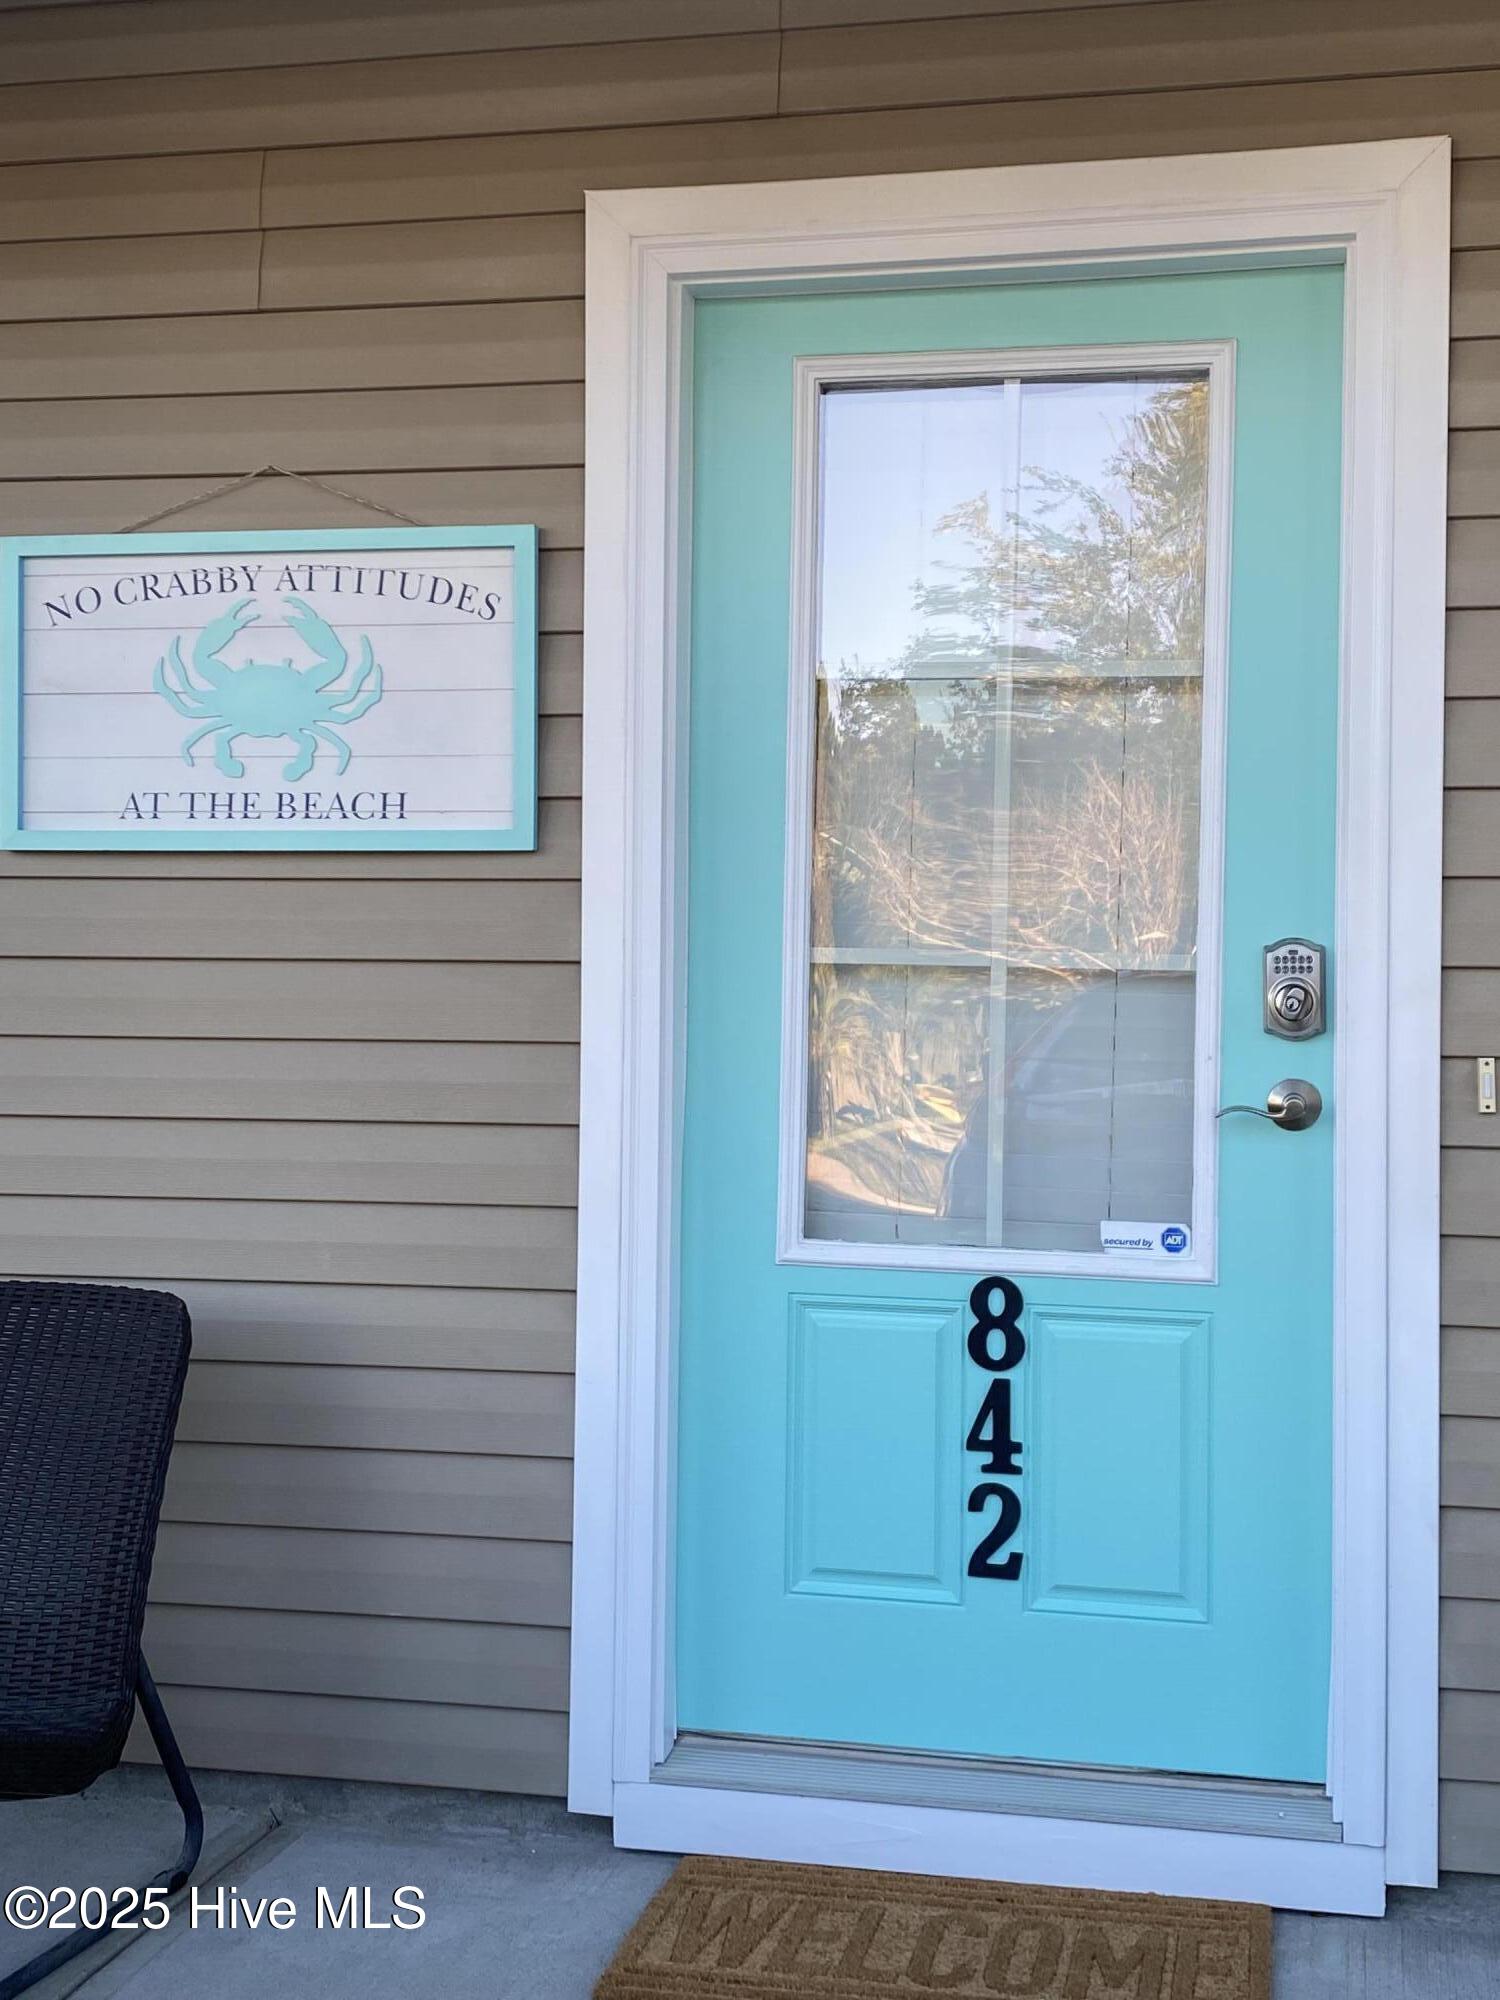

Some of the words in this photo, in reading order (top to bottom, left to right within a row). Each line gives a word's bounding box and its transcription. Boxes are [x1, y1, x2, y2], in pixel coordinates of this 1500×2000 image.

[43, 586, 102, 627] NO
[113, 564, 263, 606] CRABBY
[275, 564, 501, 621] ATTITUDES
[119, 791, 169, 820] AT
[179, 791, 261, 820] THE
[275, 791, 408, 820] BEACH
[1103, 1238, 1141, 1246] secured
[1142, 1238, 1153, 1248] by
[966, 1276, 1026, 1581] 842
[668, 1891, 1243, 2000] WELCOME
